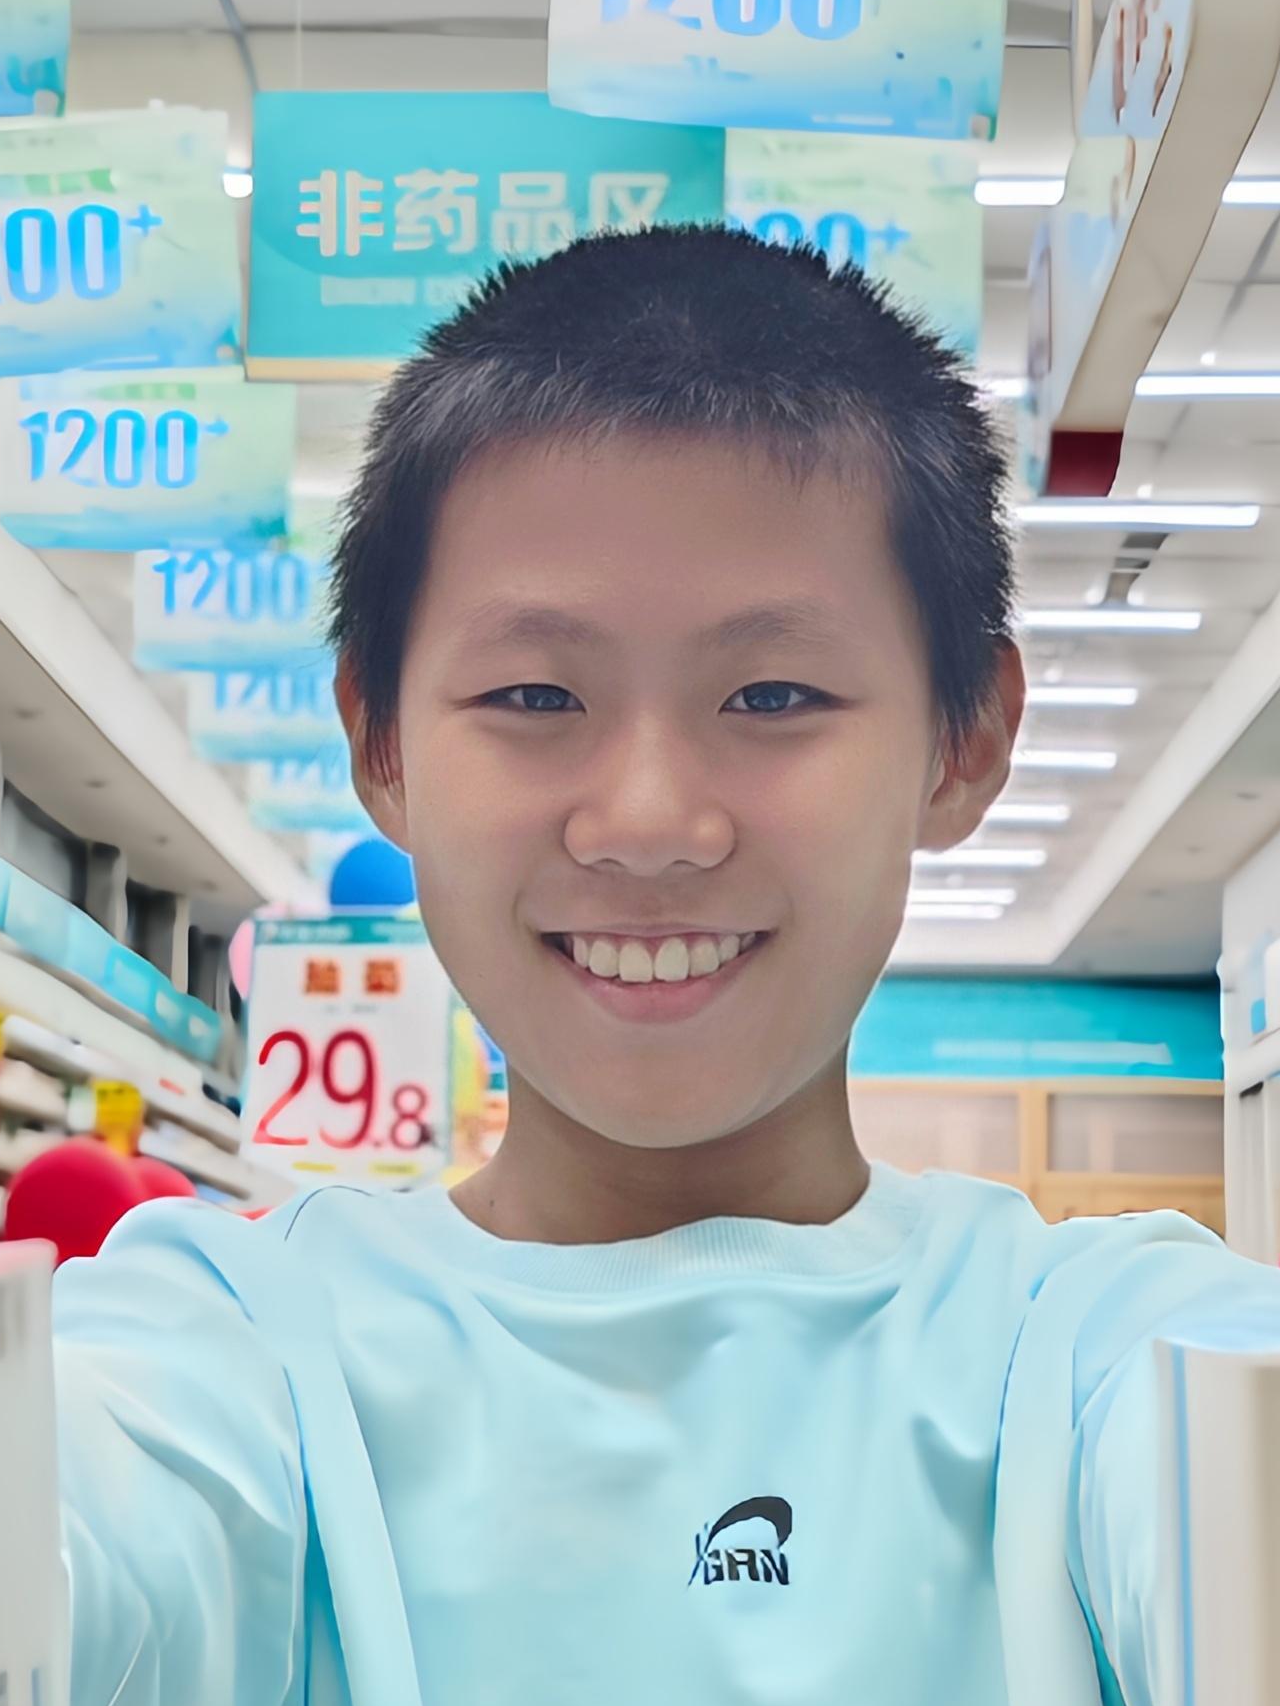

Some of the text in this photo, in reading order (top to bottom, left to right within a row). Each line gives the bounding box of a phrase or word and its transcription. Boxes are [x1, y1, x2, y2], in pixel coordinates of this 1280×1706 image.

[296, 169, 672, 259] 非药品区
[252, 1030, 428, 1151] 29.8
